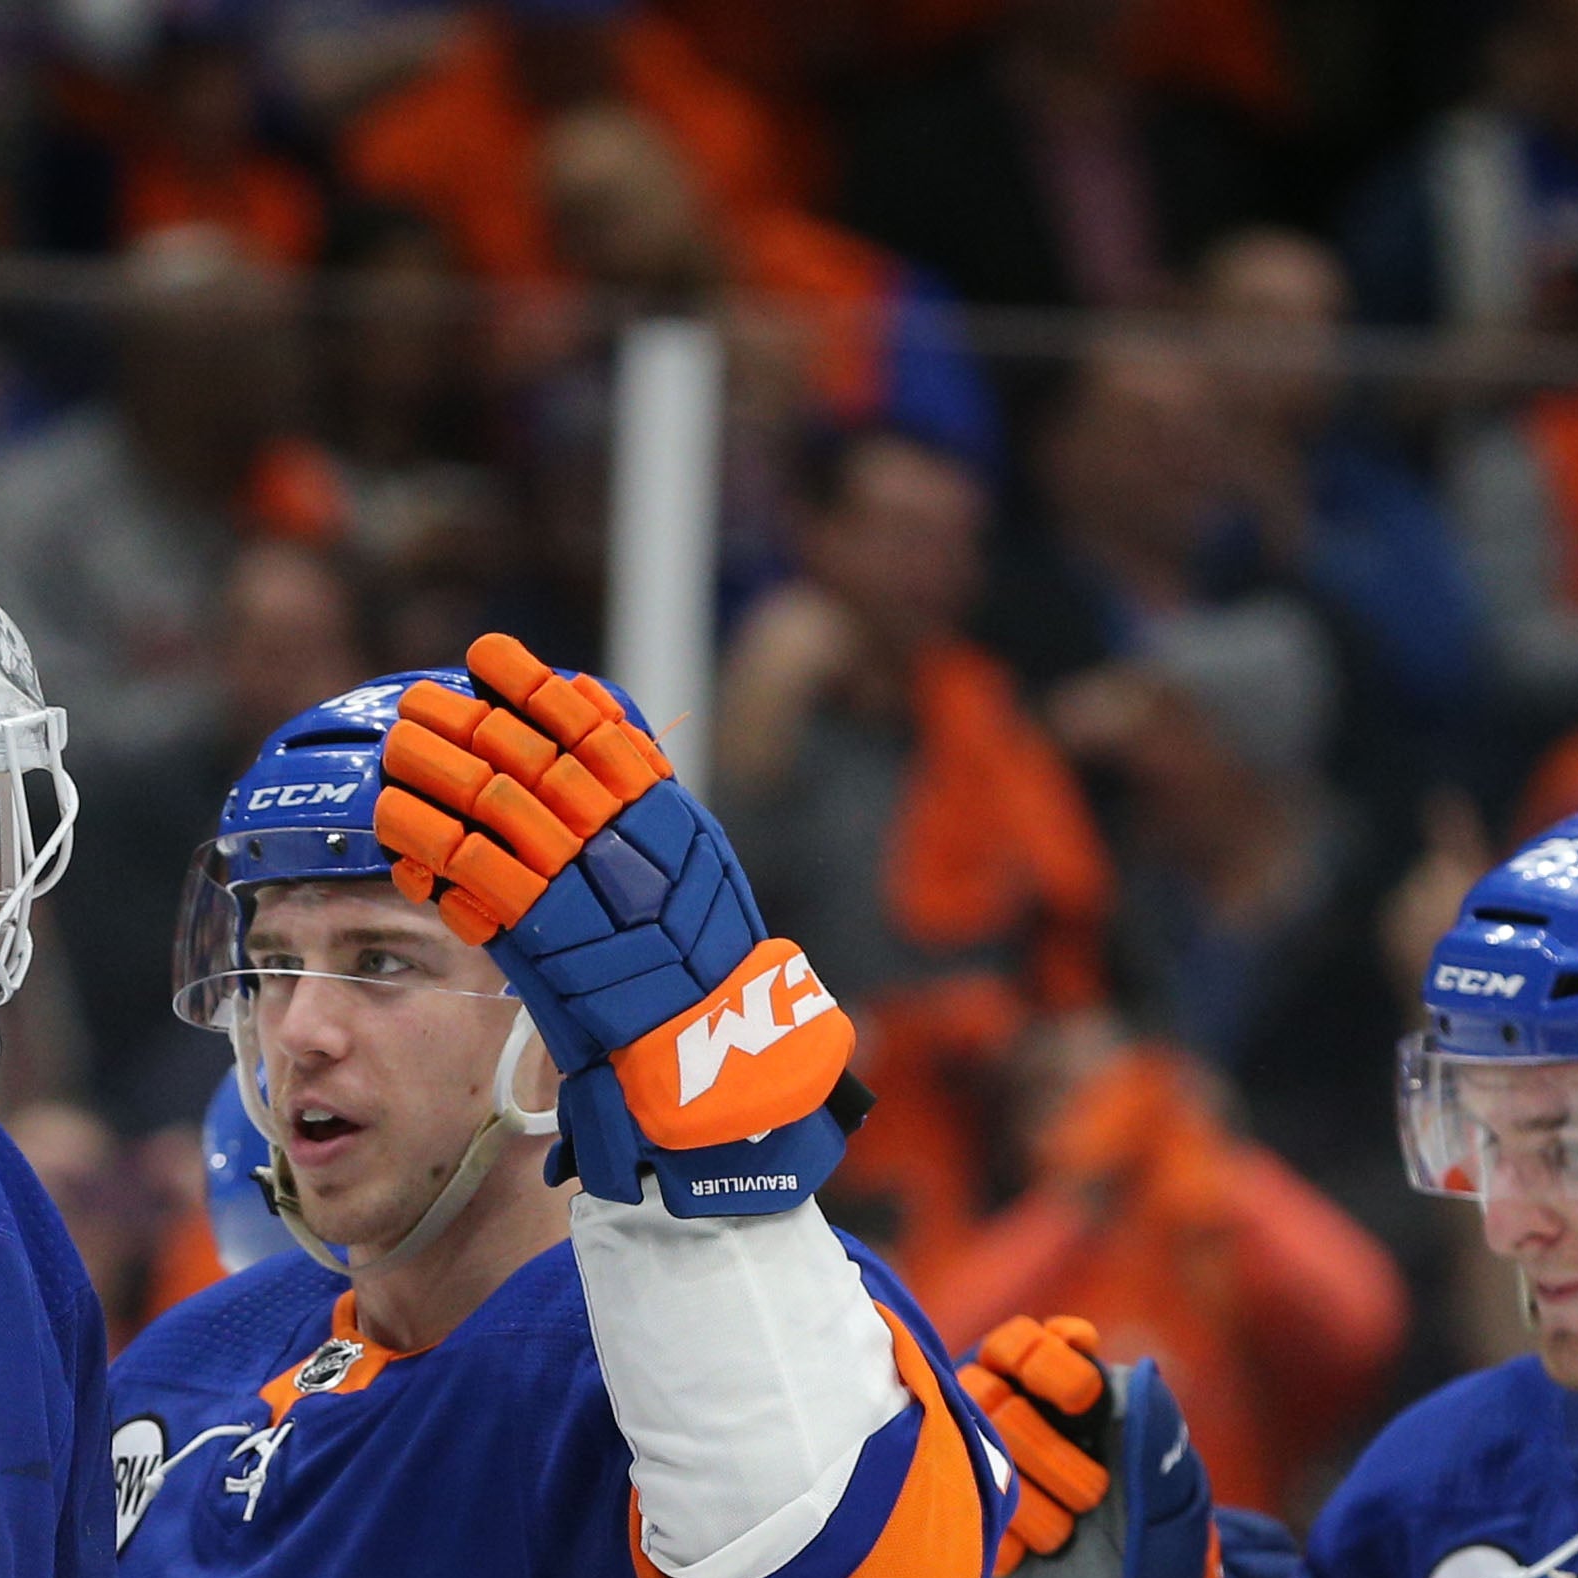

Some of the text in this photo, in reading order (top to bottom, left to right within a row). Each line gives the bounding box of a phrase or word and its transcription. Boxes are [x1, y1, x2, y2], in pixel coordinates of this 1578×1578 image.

[247, 782, 360, 811] CCM
[1433, 964, 1527, 999] CCM
[691, 1174, 799, 1196] BEAUVILLIER
